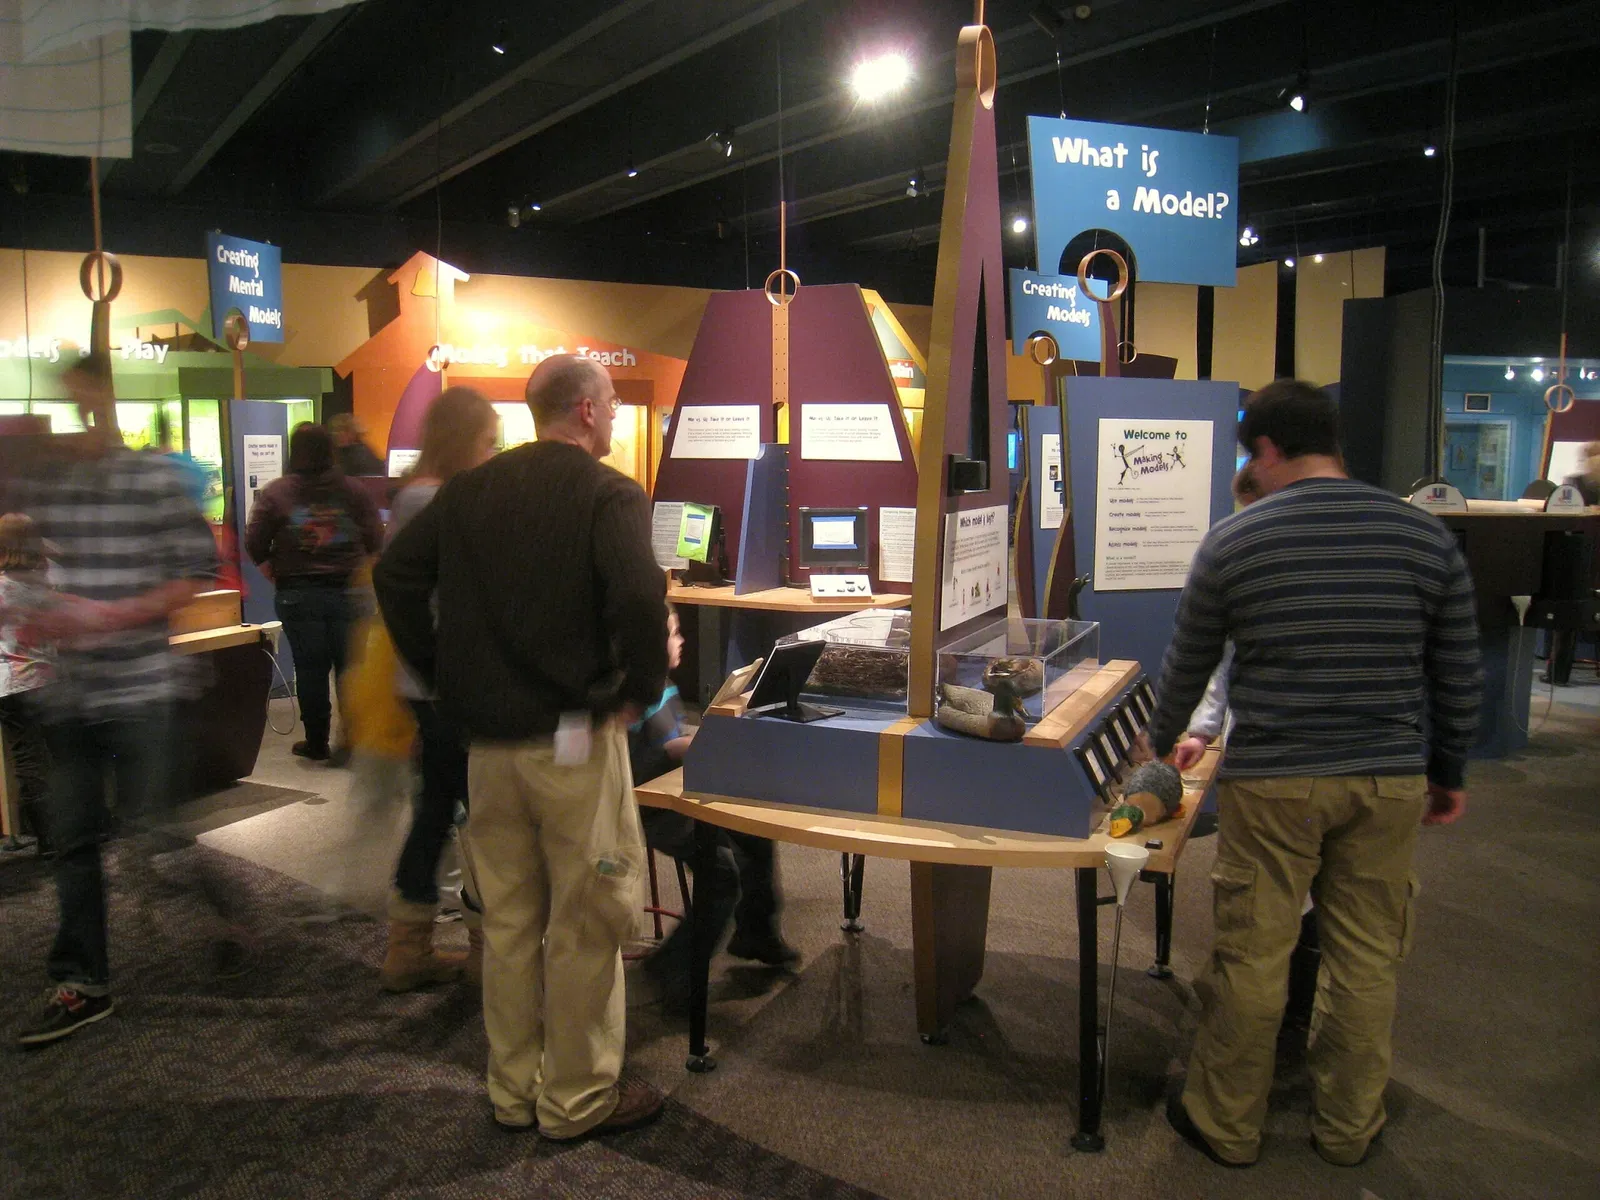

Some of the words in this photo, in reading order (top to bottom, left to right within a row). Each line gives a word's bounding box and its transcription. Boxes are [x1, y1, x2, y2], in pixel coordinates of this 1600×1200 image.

[1052, 136, 1129, 169] What
[1141, 144, 1160, 177] is
[1106, 190, 1120, 211] a
[1133, 186, 1229, 219] Model?
[217, 245, 260, 278] Creating
[229, 275, 264, 297] Mental
[1022, 280, 1077, 307] Creating
[249, 305, 282, 329] Models
[1047, 306, 1091, 328] Models
[120, 338, 169, 364] Play
[575, 346, 636, 367] Teach
[1123, 429, 1170, 440] Welcome
[1175, 430, 1188, 440] to
[1133, 452, 1163, 465] Making
[1140, 462, 1169, 475] Models
